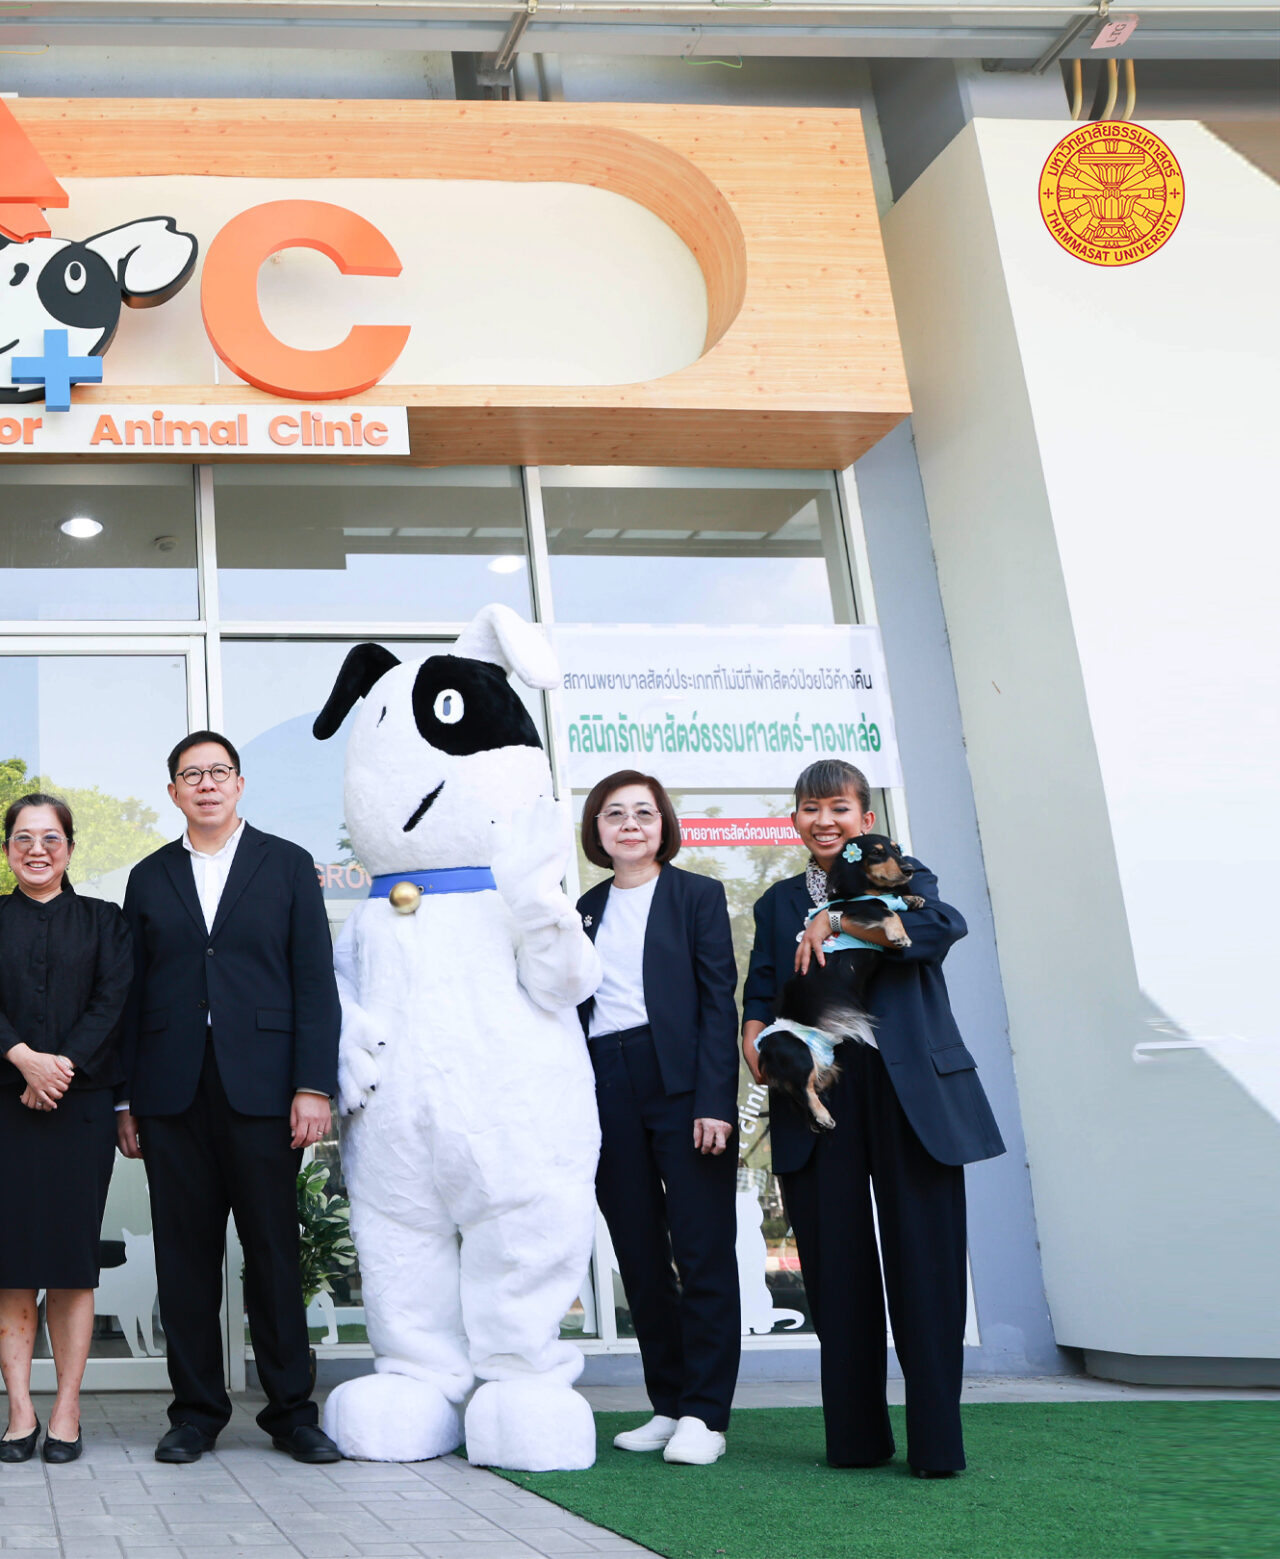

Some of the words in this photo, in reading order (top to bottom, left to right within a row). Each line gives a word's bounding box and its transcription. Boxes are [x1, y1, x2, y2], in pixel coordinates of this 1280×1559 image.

[90, 411, 248, 447] Animal
[267, 411, 390, 447] Clinic
[563, 664, 873, 690] สถานพยาบาลสัตว์ประเภทที่ไม่มีที่พักสัตว์ป่วยไว้ค้างคืน
[568, 711, 881, 753] คลินิกรักษาสัตว์ธรรมศาสตร์-ทองหล่อ
[315, 864, 372, 889] GRO
[738, 1083, 769, 1134] clini
